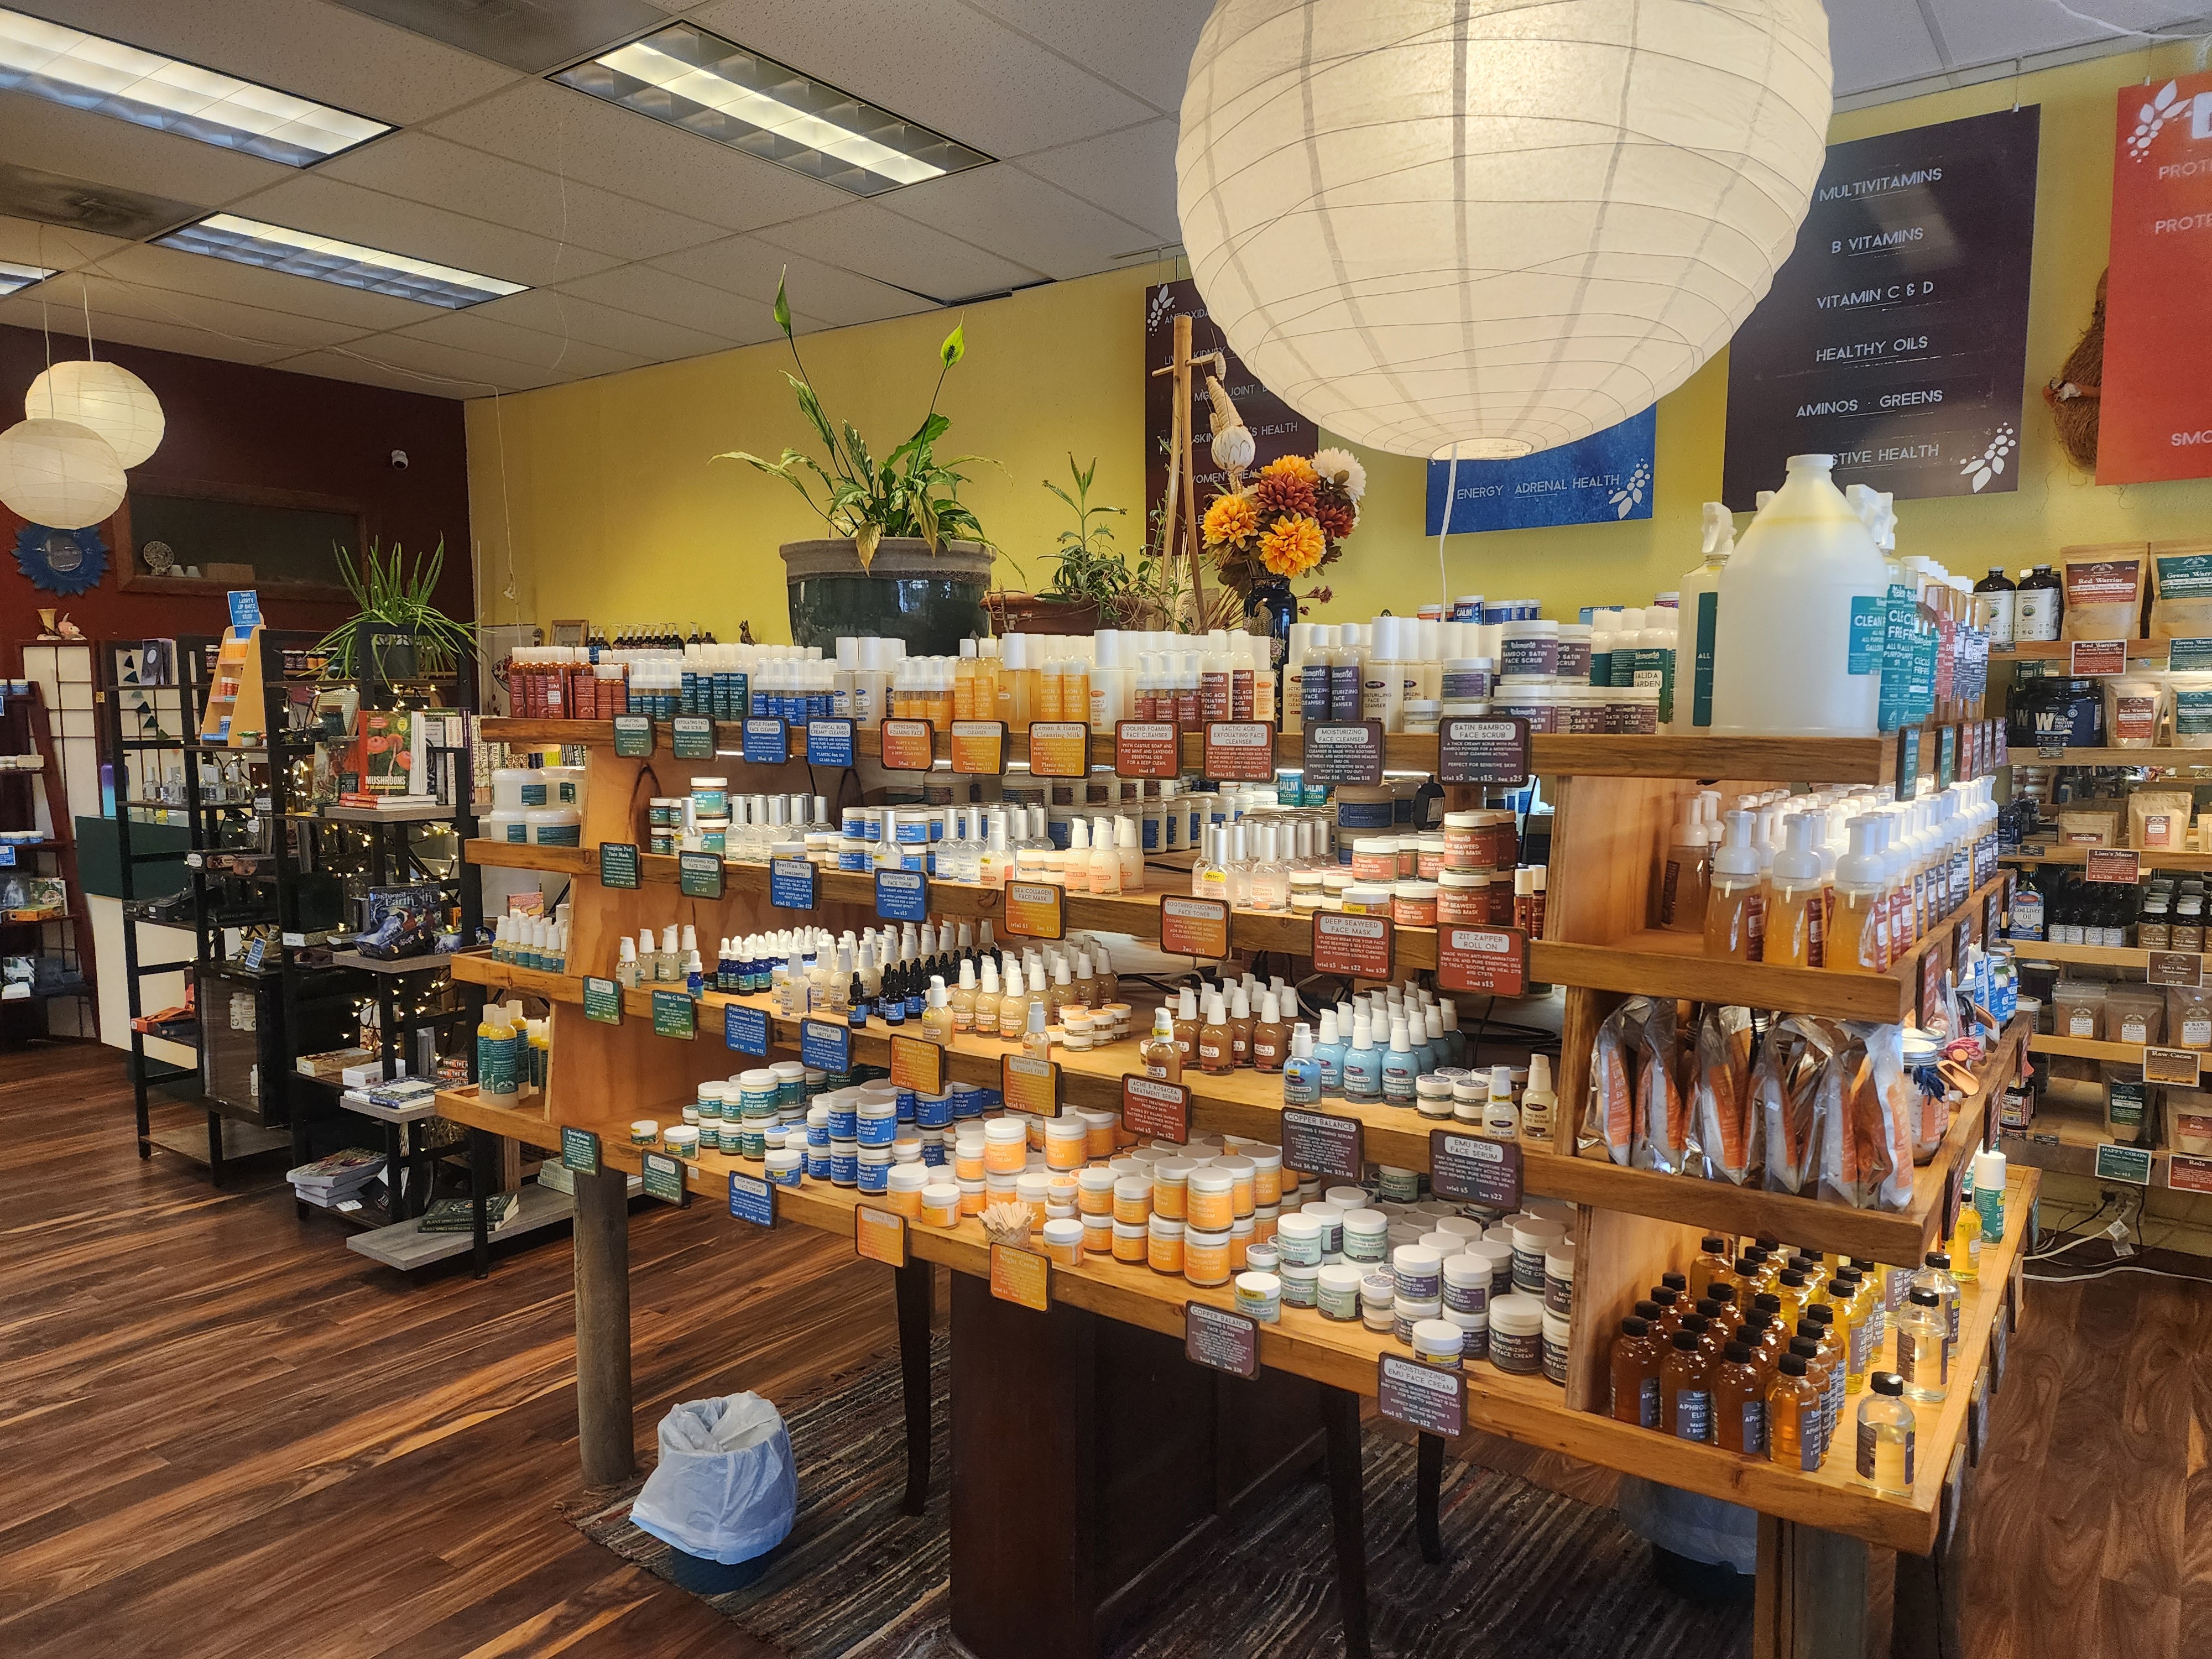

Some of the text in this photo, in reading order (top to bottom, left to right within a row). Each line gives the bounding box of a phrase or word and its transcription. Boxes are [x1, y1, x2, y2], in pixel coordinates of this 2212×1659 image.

[1819, 168, 1942, 201] MULTIVITAMINS
[1832, 227, 1923, 254] B VITAMINS
[1817, 281, 1934, 309] VITAMIN C & D
[1817, 336, 1928, 362] HEALTHY OILS
[1230, 384, 1255, 397] JOINT
[1796, 390, 1943, 418] AMINOS GREENS
[1261, 421, 1298, 436] HEALTH
[1879, 444, 1939, 461] HEALTH
[1457, 474, 1620, 500] ENERGY ADRENAL HEALTH
[366, 776, 405, 785] MUSHROOMS
[1280, 781, 1298, 791] CALM
[1304, 784, 1324, 792] CALM
[374, 891, 406, 900] Enchanted
[385, 894, 418, 907] Earth
[728, 1006, 749, 1015] Hydrating
[728, 1013, 749, 1021] Treatment
[1131, 1086, 1180, 1102] TREATMENT SERUM
[1153, 1085, 1177, 1094] ROSACEA
[1287, 1113, 1353, 1130] COPPER BALANCE
[1450, 1146, 1498, 1160] FACE SERUM
[1454, 1139, 1493, 1151] EMU ROSE
[999, 1254, 1039, 1270] Night Cream
[1000, 1247, 1039, 1265] Moisturizing
[1193, 1308, 1250, 1329] COPPER BALANCE
[1388, 1368, 1453, 1392] EMU FACE CREAM
[1395, 1363, 1446, 1381] MOISTURIZING
